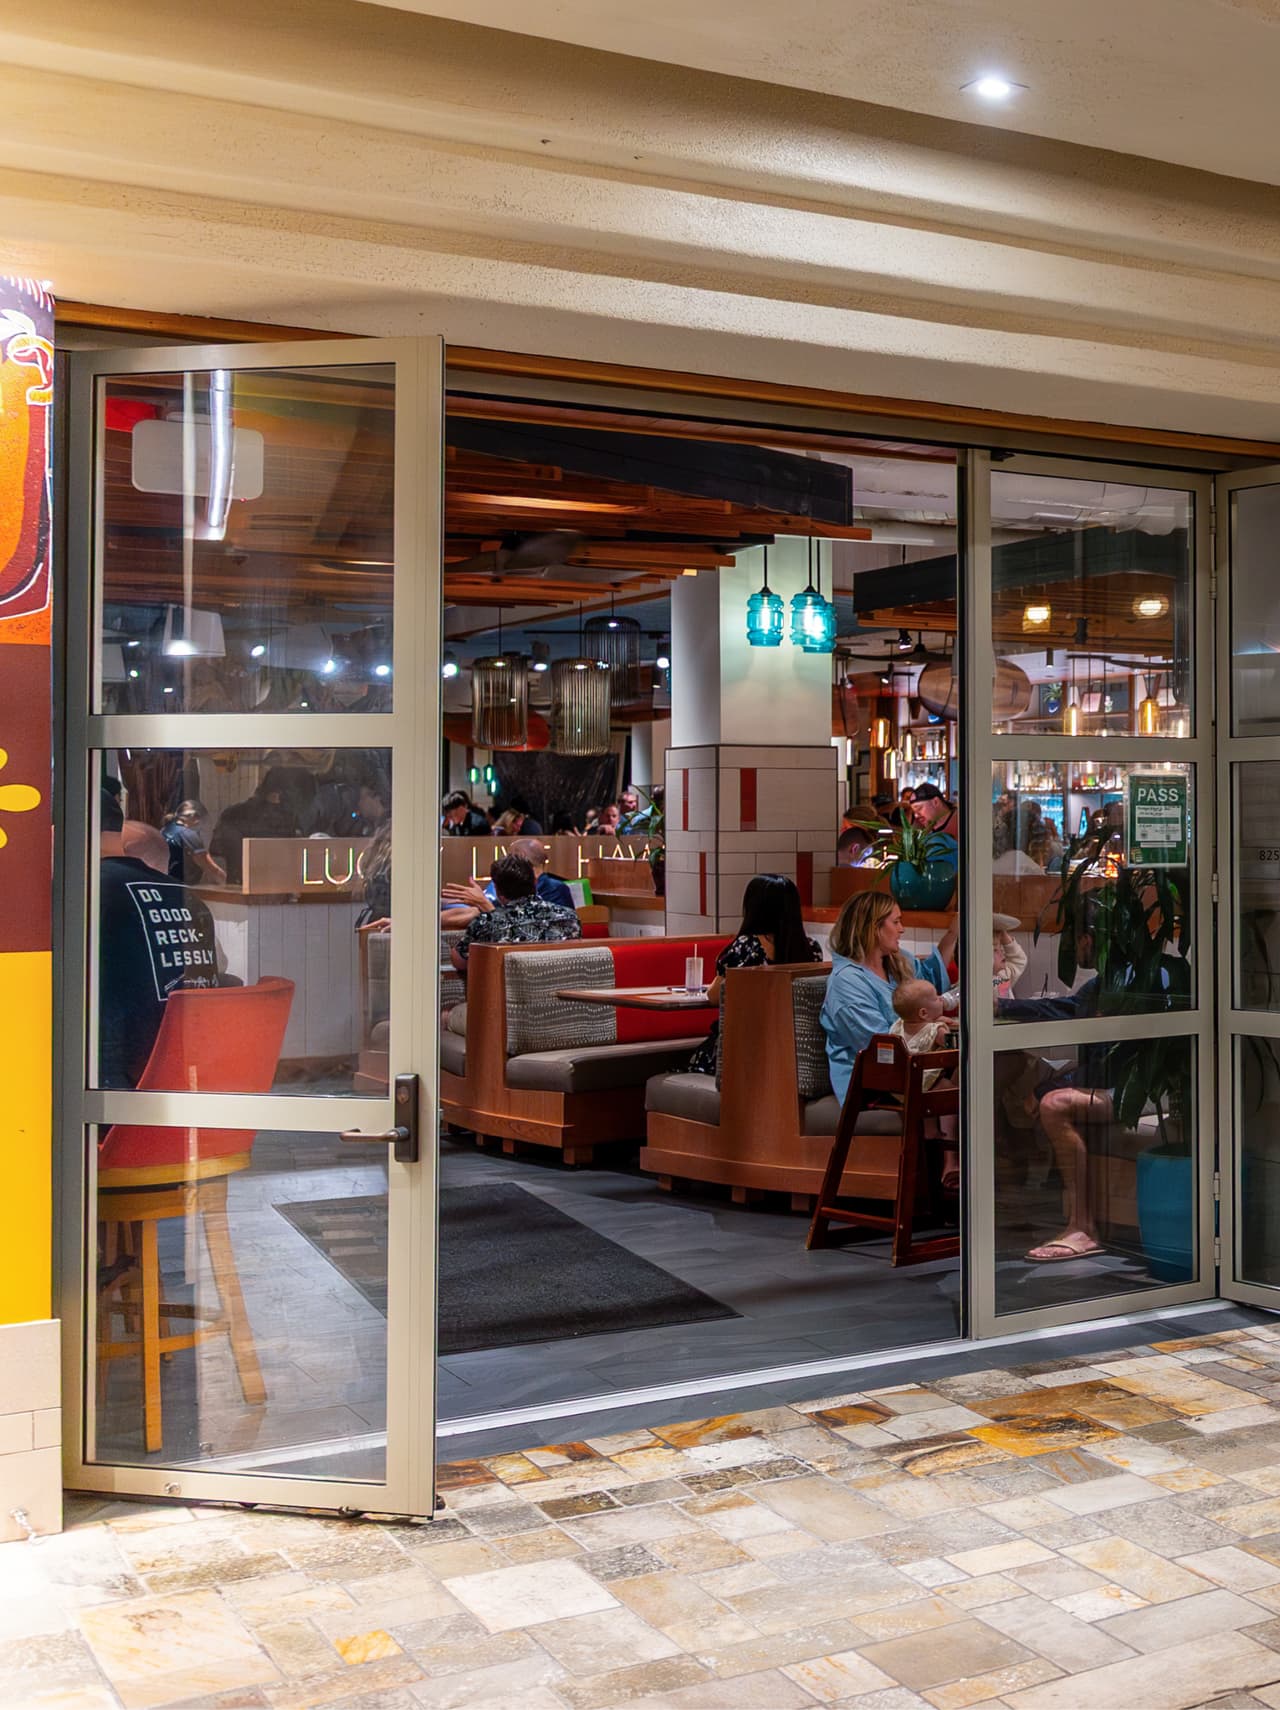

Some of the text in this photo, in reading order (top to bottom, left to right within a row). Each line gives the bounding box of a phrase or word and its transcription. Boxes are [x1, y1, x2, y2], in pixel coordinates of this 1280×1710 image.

[1137, 787, 1179, 802] PASS
[138, 889, 163, 902] DO
[149, 908, 193, 923] GOOD
[155, 928, 204, 945] RECK-
[160, 949, 215, 968] LESSLY
